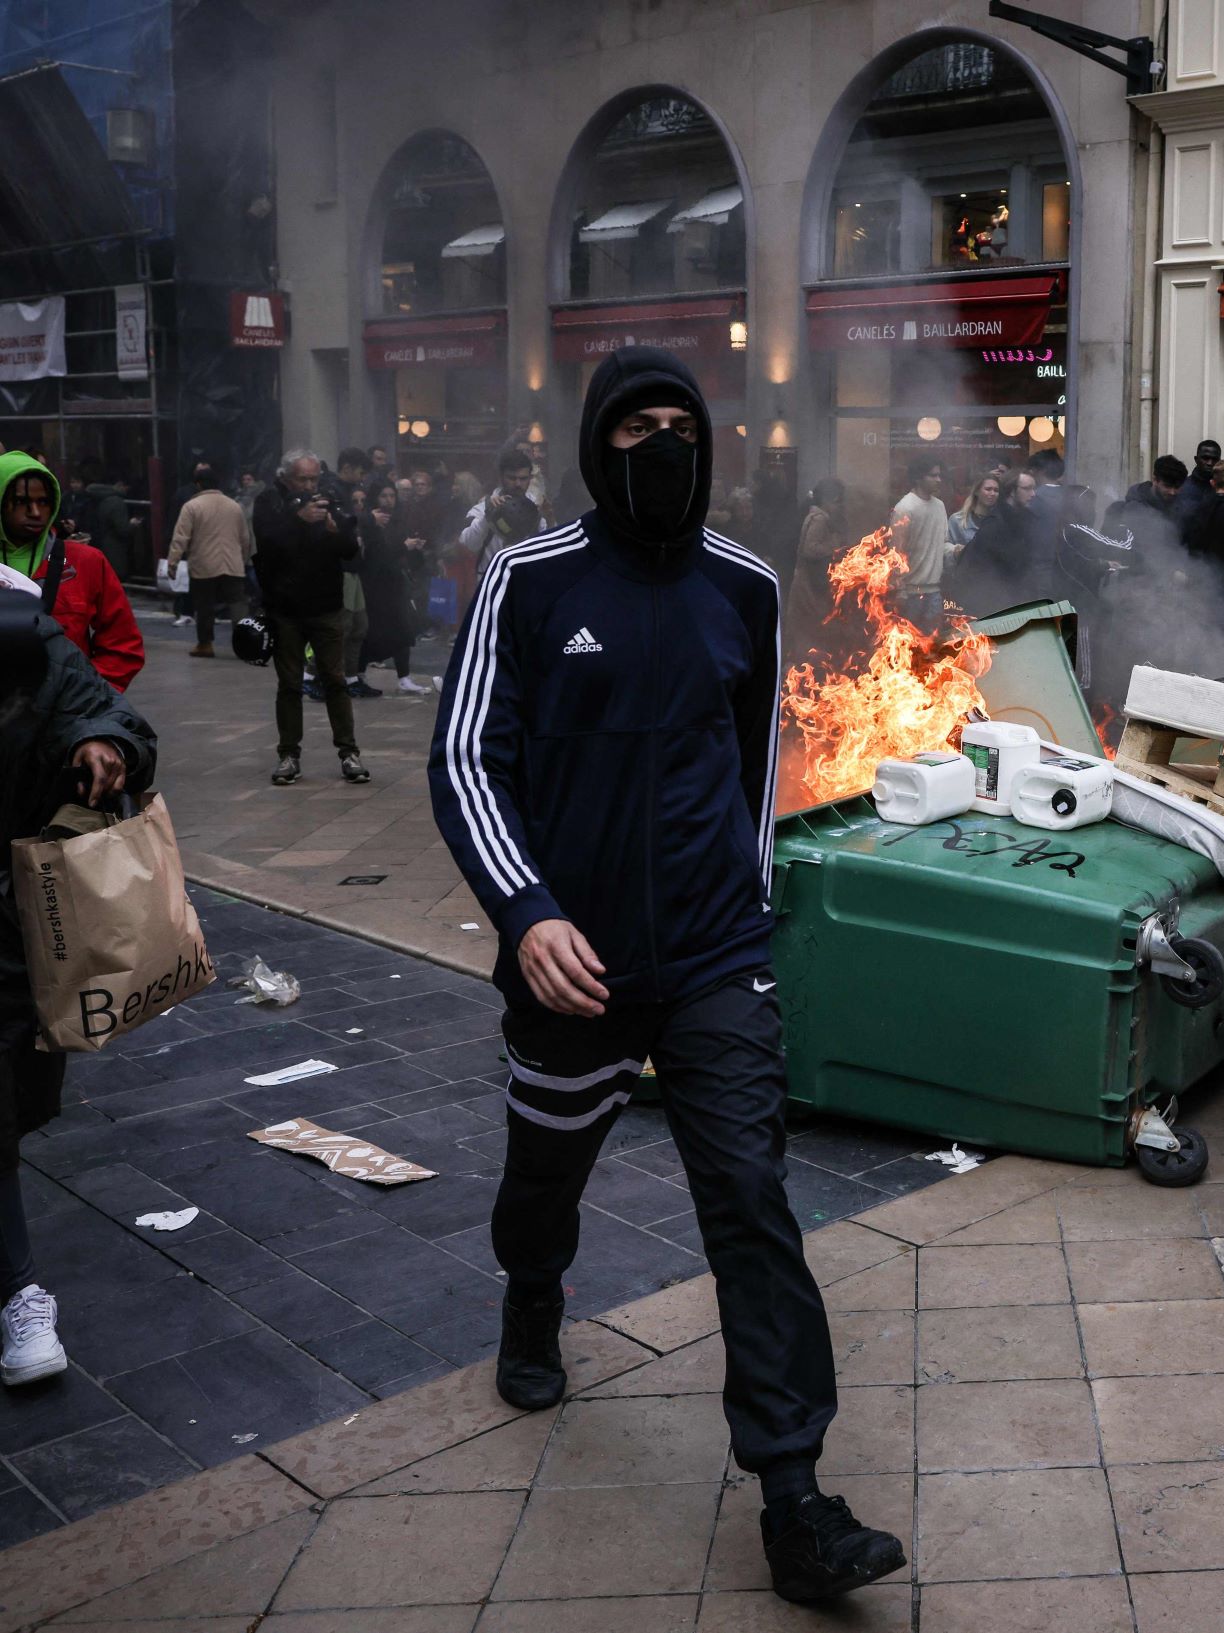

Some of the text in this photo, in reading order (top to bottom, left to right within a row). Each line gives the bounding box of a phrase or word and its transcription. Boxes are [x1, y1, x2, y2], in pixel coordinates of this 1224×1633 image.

[847, 320, 1003, 341] CANELÉS BAILLARDRAN
[1036, 365, 1067, 378] BAILL
[563, 643, 603, 655] adidas
[38, 862, 69, 962] #bershkastyle
